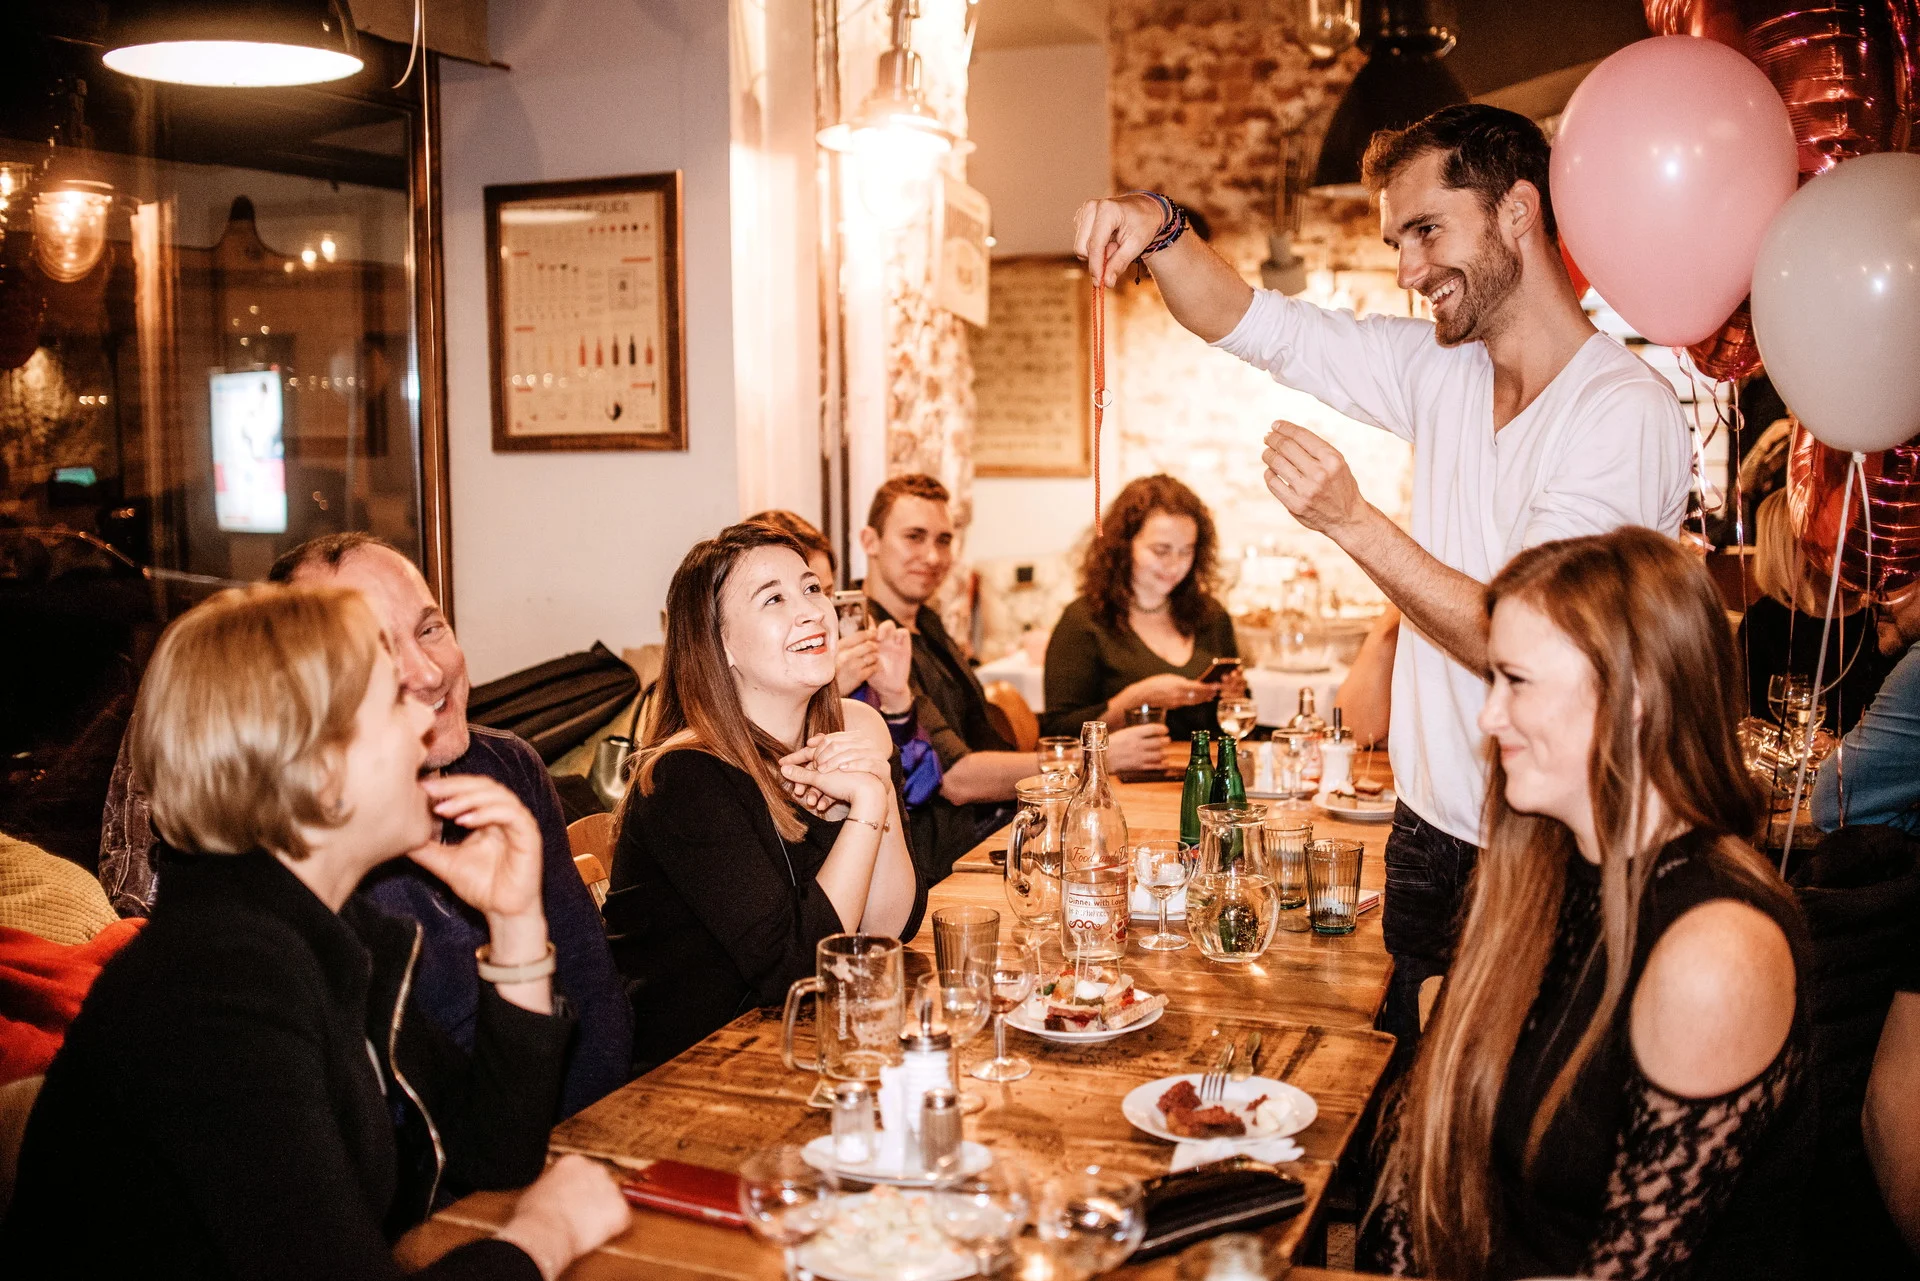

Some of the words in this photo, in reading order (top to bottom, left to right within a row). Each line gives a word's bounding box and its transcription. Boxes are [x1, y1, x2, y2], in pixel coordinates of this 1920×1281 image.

[1072, 846, 1096, 863] Food
[1099, 850, 1117, 864] and
[1068, 896, 1091, 906] Dinner
[1093, 898, 1110, 907] with
